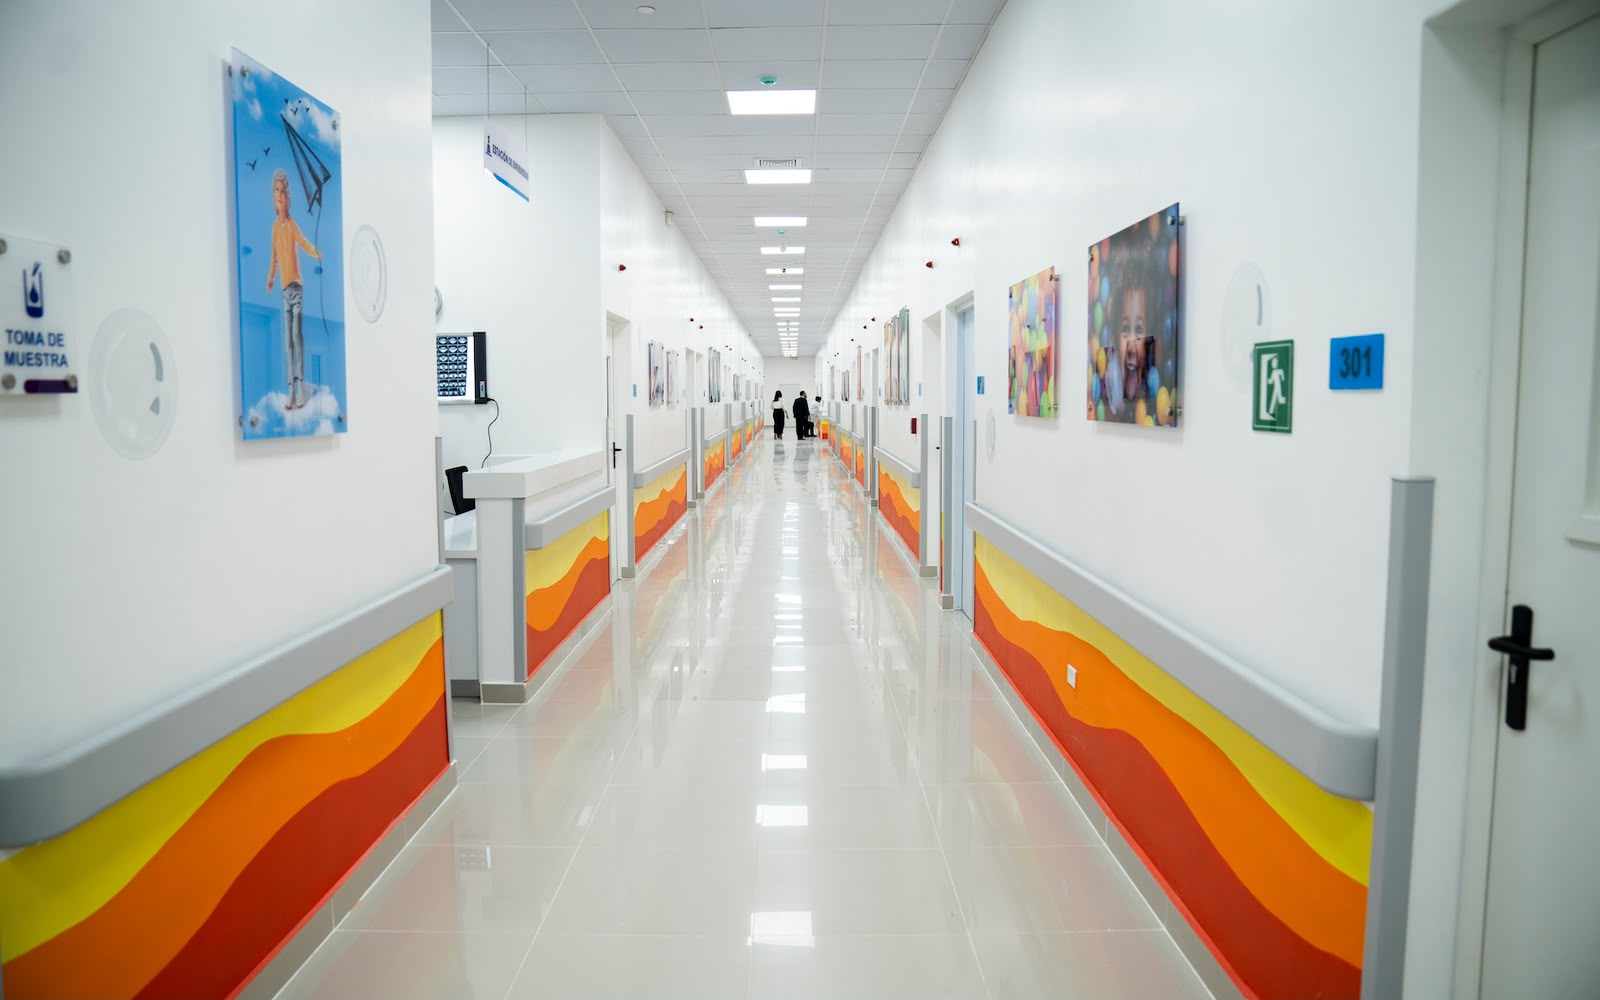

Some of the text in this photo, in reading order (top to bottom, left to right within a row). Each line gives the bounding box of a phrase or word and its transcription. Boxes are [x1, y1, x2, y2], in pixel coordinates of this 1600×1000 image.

[5, 329, 65, 347] TOMA DE
[4, 350, 69, 368] MUESTRA
[1340, 345, 1372, 378] 301
